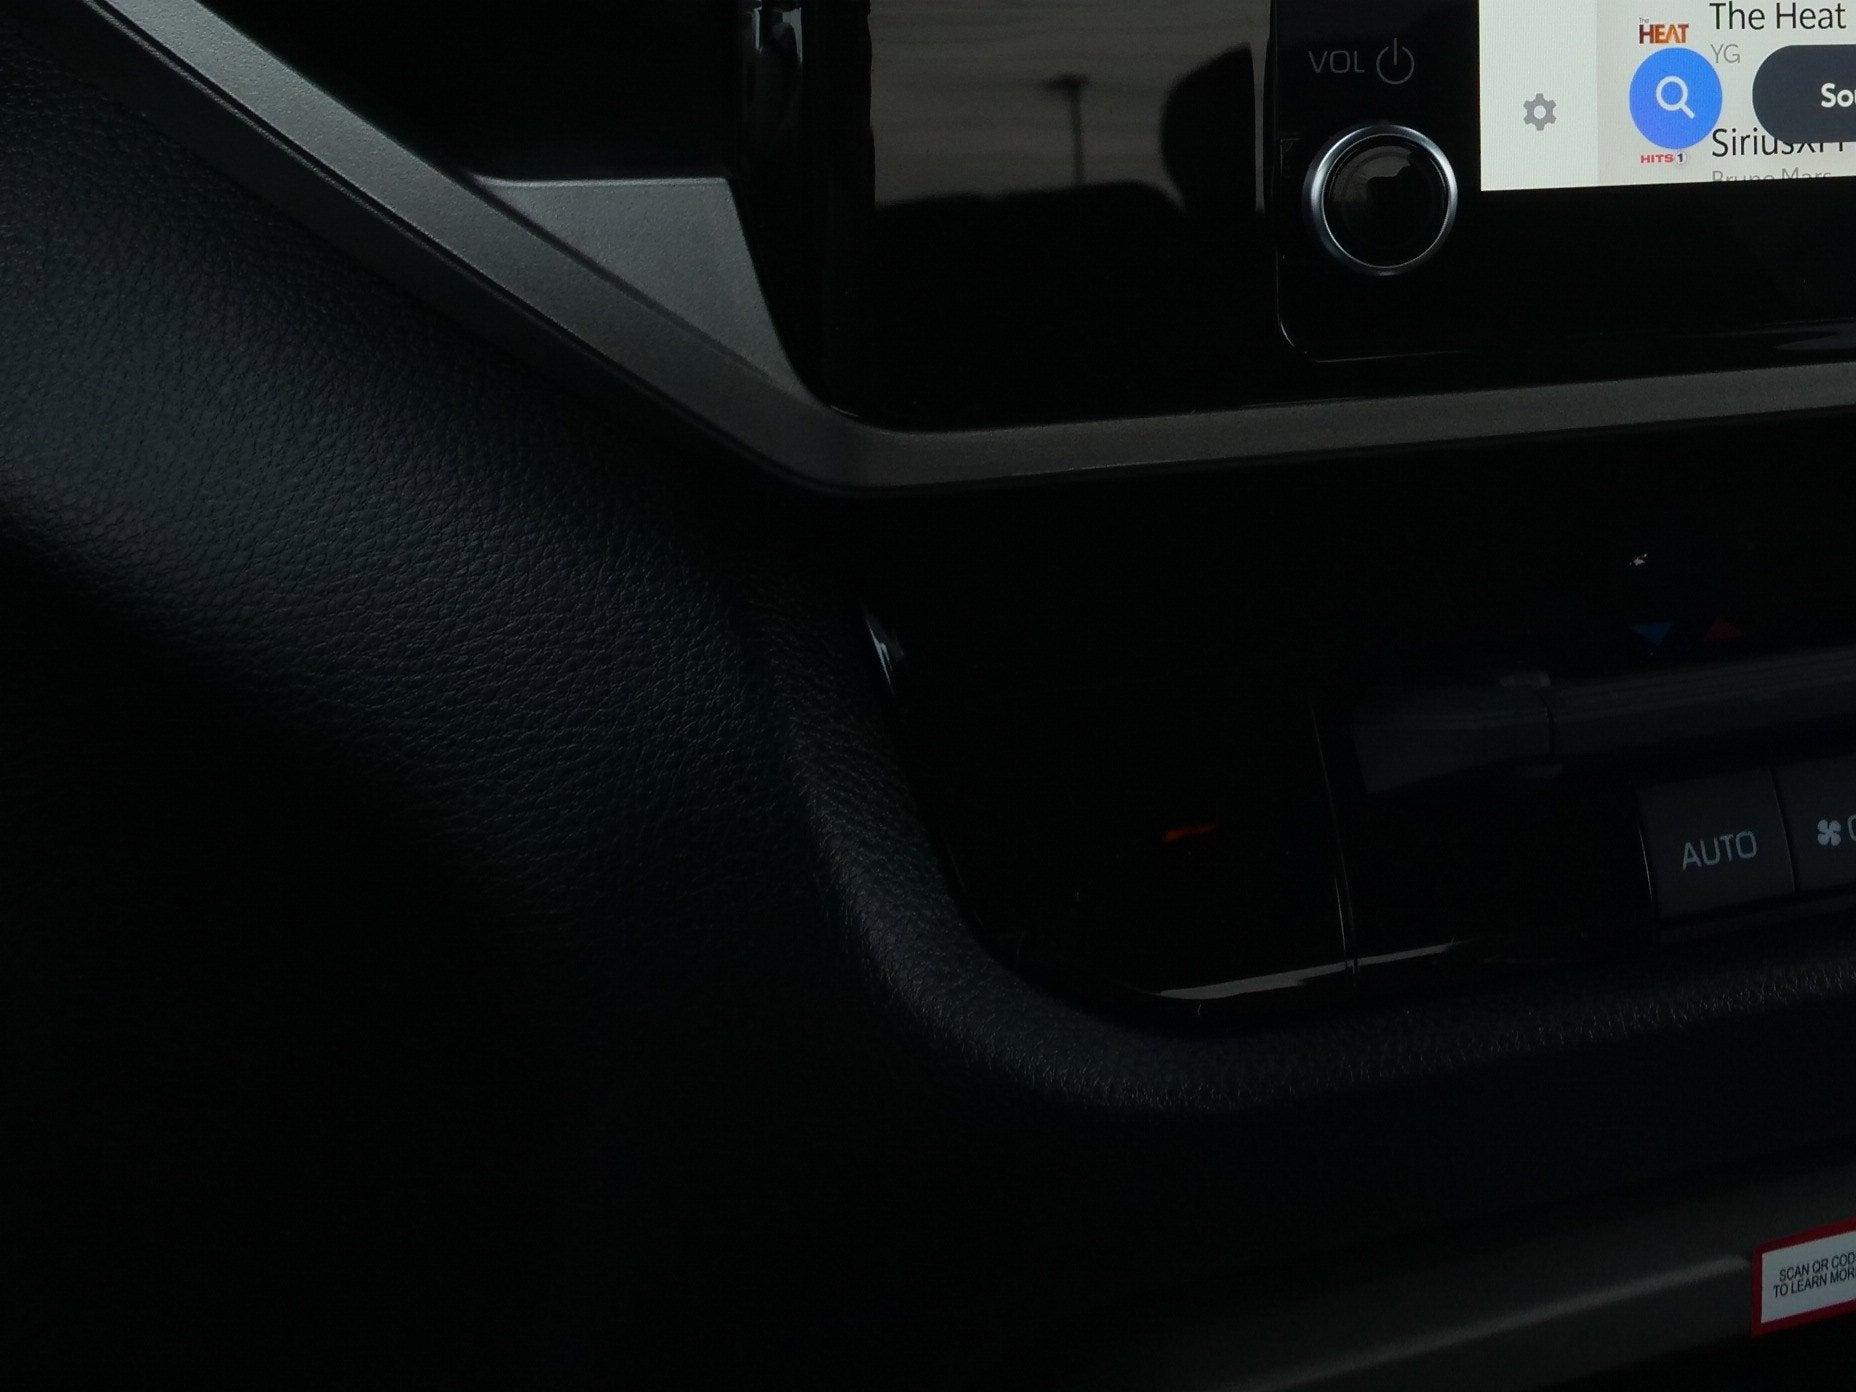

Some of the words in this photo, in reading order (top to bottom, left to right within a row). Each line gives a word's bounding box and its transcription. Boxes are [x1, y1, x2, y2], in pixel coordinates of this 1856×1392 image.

[1709, 0, 1765, 30] The
[1775, 2, 1847, 30] Heat
[1639, 23, 1689, 44] HEAT
[1308, 50, 1365, 74] VOL
[1711, 43, 1741, 64] YG
[1640, 153, 1674, 164] HITS
[1682, 830, 1757, 870] AUTO
[1779, 1262, 1810, 1282] SCAN
[1774, 1284, 1789, 1298] TO
[1791, 1275, 1827, 1294] LEARN
